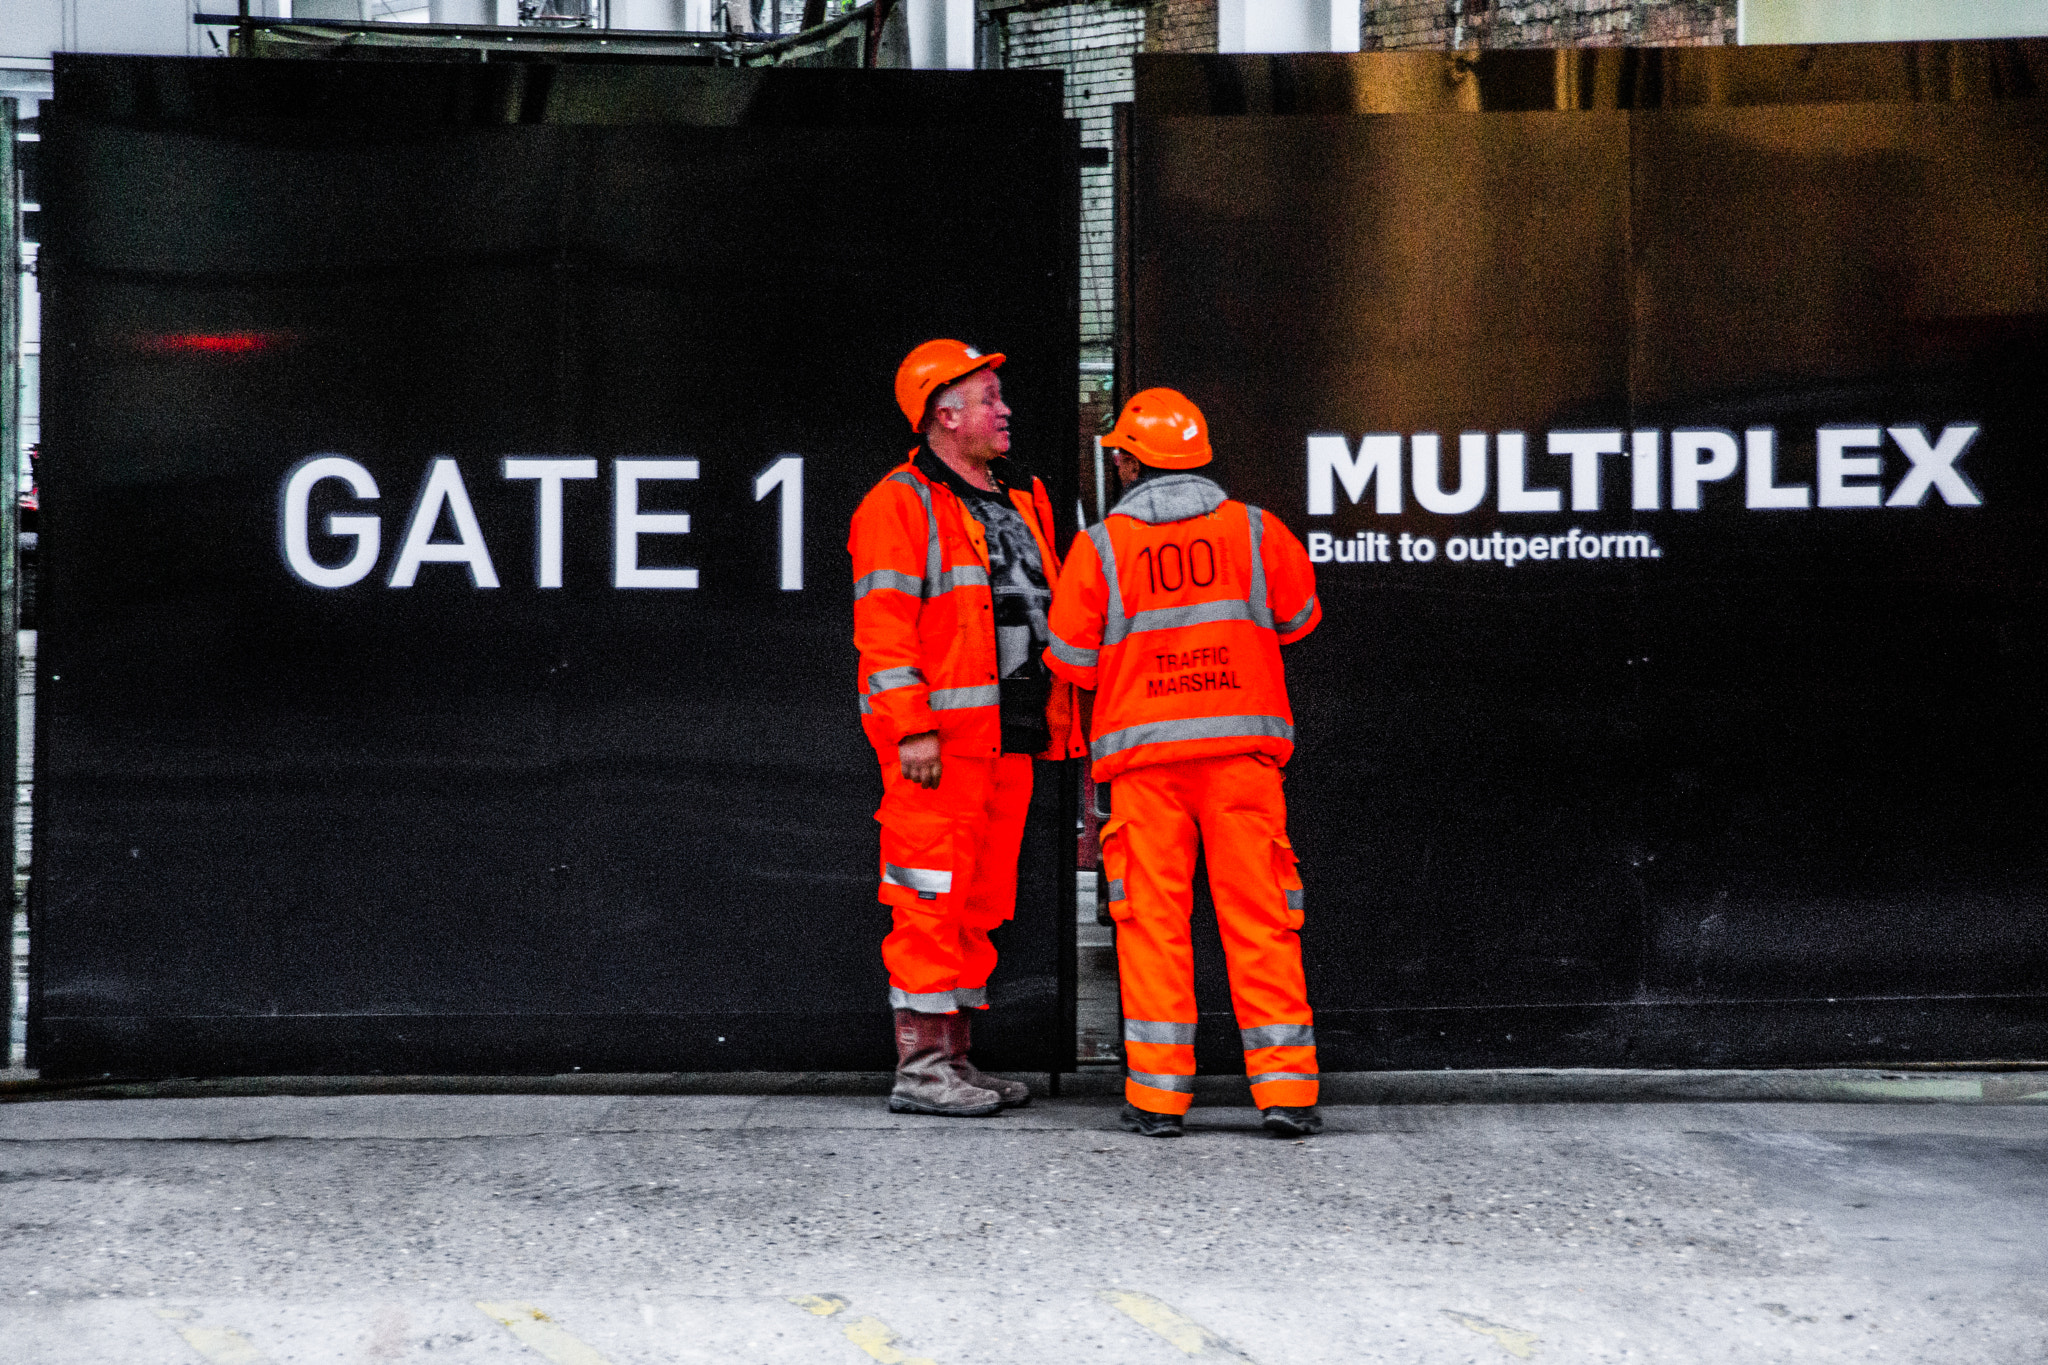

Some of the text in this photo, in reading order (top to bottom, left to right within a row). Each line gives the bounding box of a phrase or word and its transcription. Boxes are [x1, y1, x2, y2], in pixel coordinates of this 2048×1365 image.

[1306, 426, 1981, 515] MULTIPLEX
[284, 457, 804, 590] GATE 1
[1138, 538, 1215, 594] 100
[1307, 528, 1661, 567] Built to outperform.
[1156, 646, 1229, 673] TRAFFIC
[1147, 671, 1241, 698] MARSHAL
